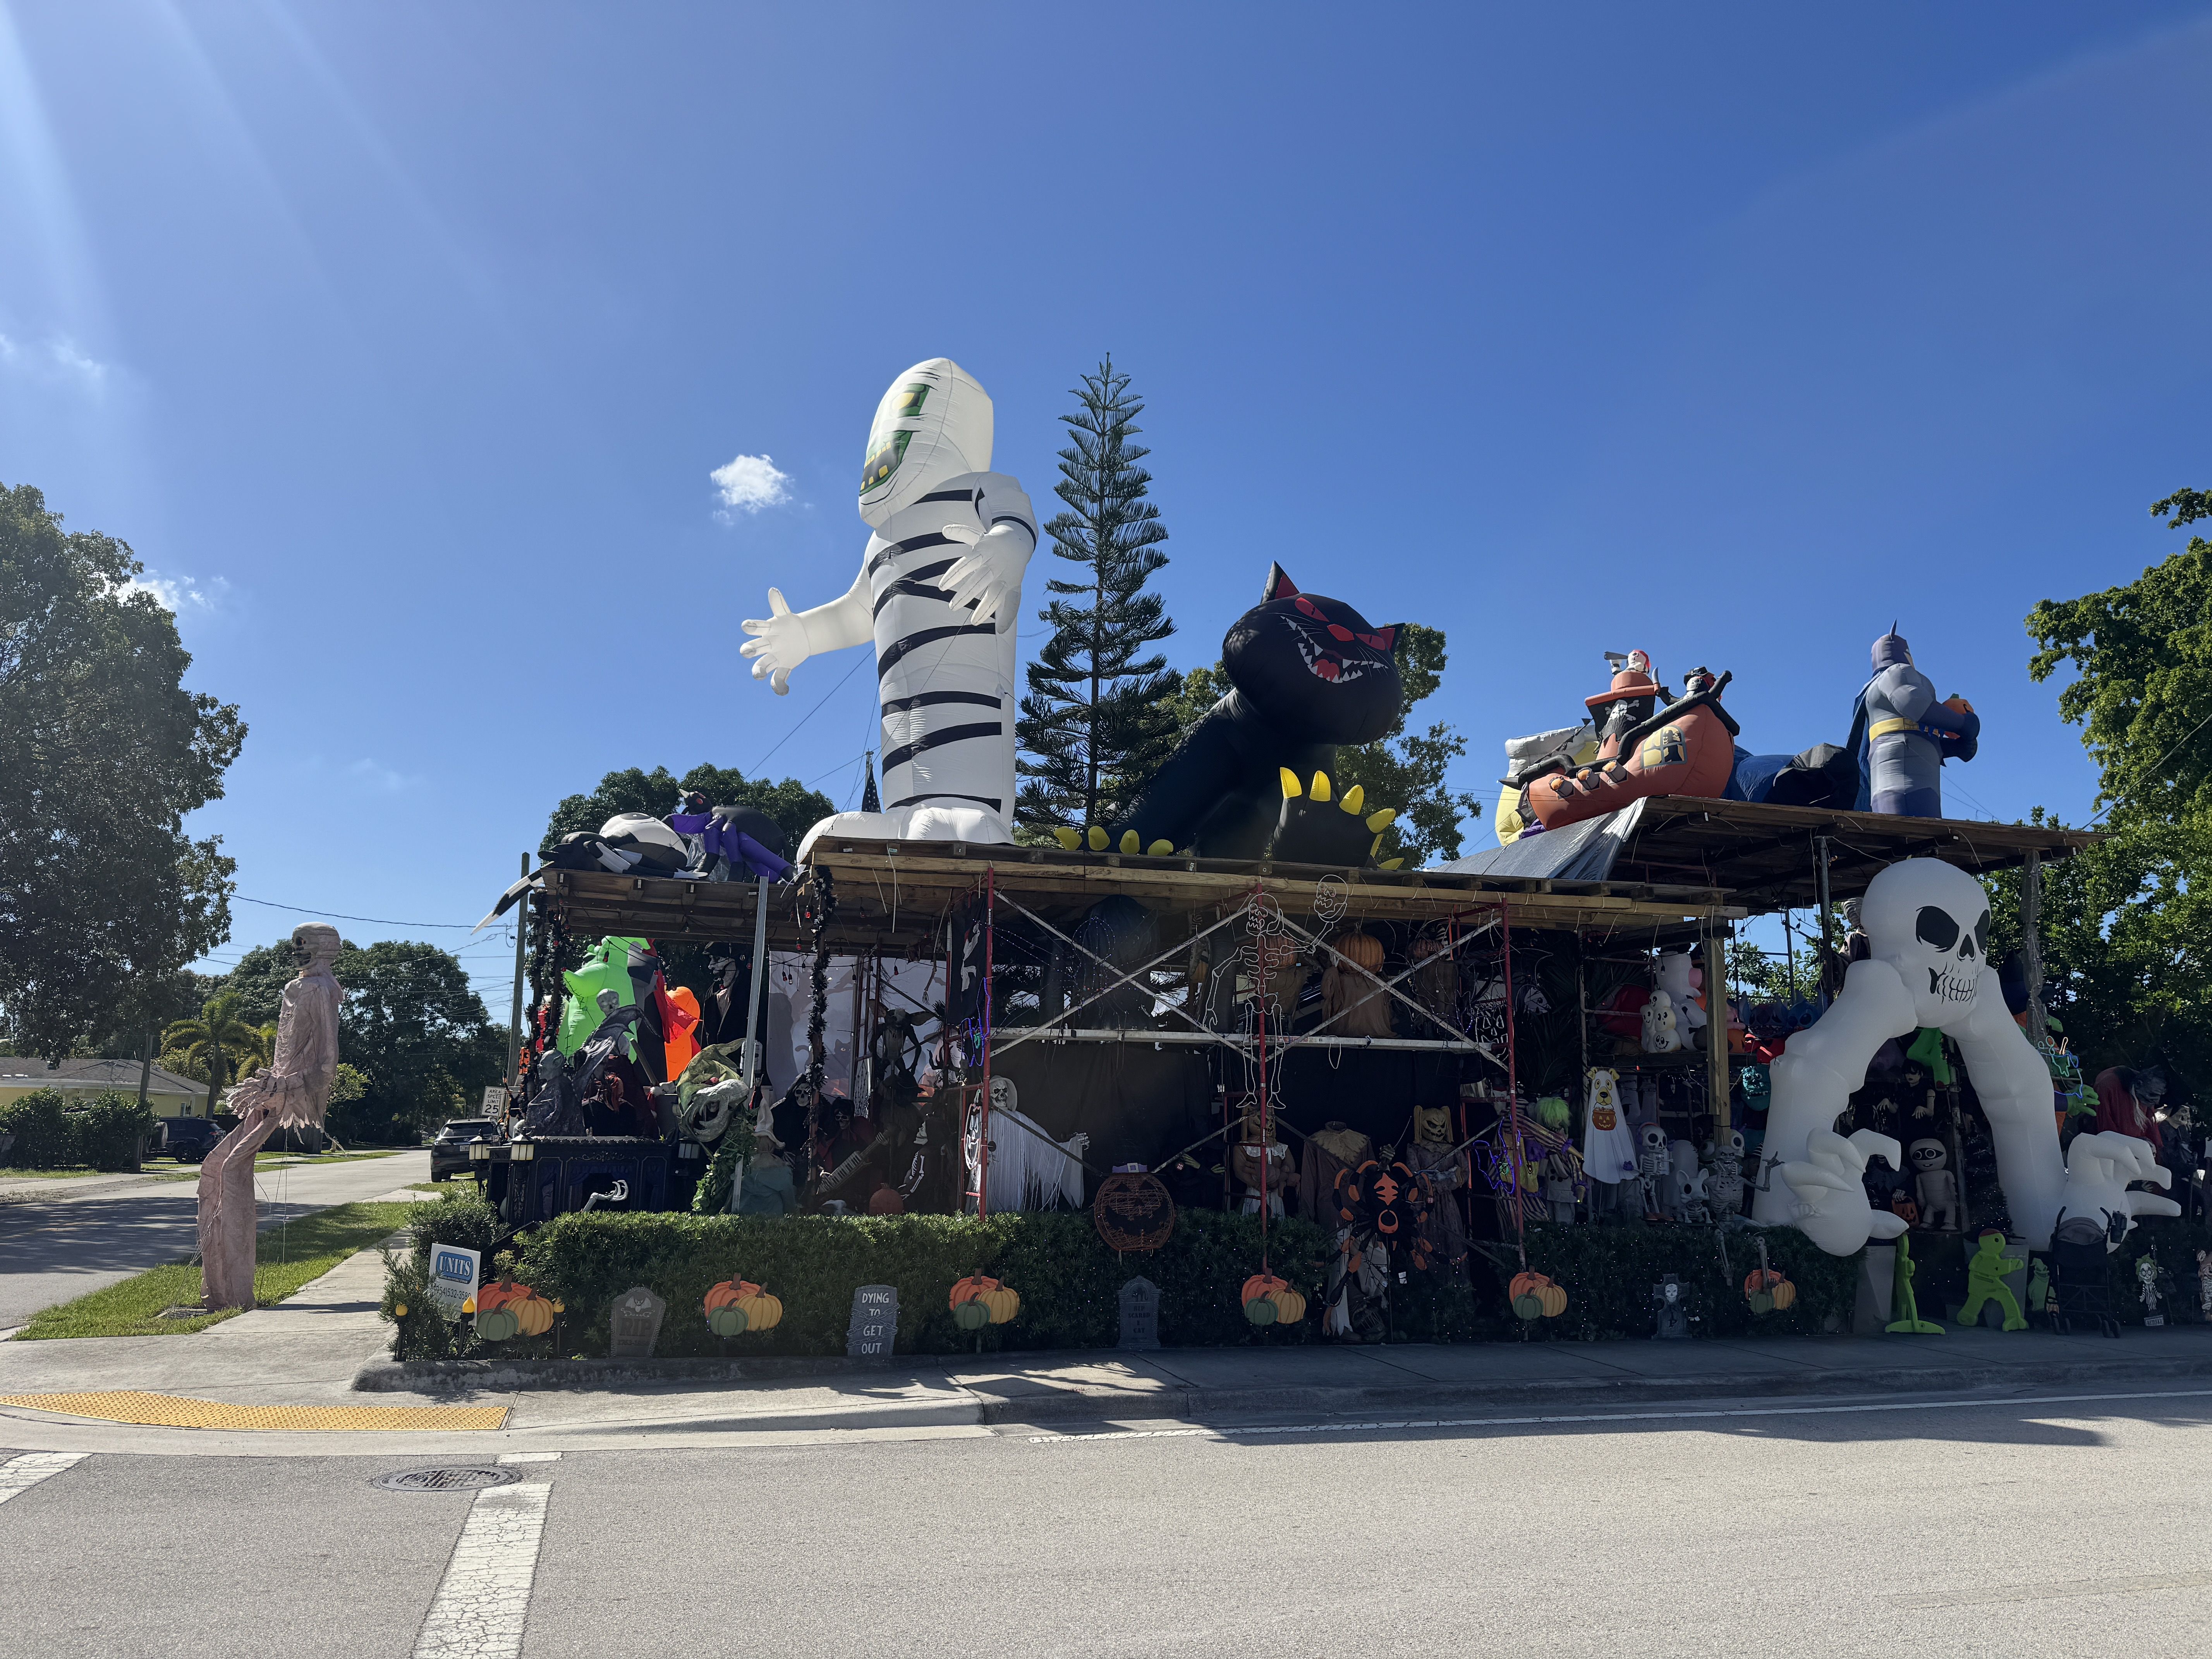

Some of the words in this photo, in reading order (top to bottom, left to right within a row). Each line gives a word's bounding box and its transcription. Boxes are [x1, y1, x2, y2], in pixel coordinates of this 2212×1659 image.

[485, 1104, 498, 1113] 25
[439, 1256, 471, 1276] UNITS
[862, 1293, 889, 1304] DYING
[619, 1318, 652, 1336] RIP
[863, 1325, 883, 1336] GET
[861, 1343, 882, 1354] OUT
